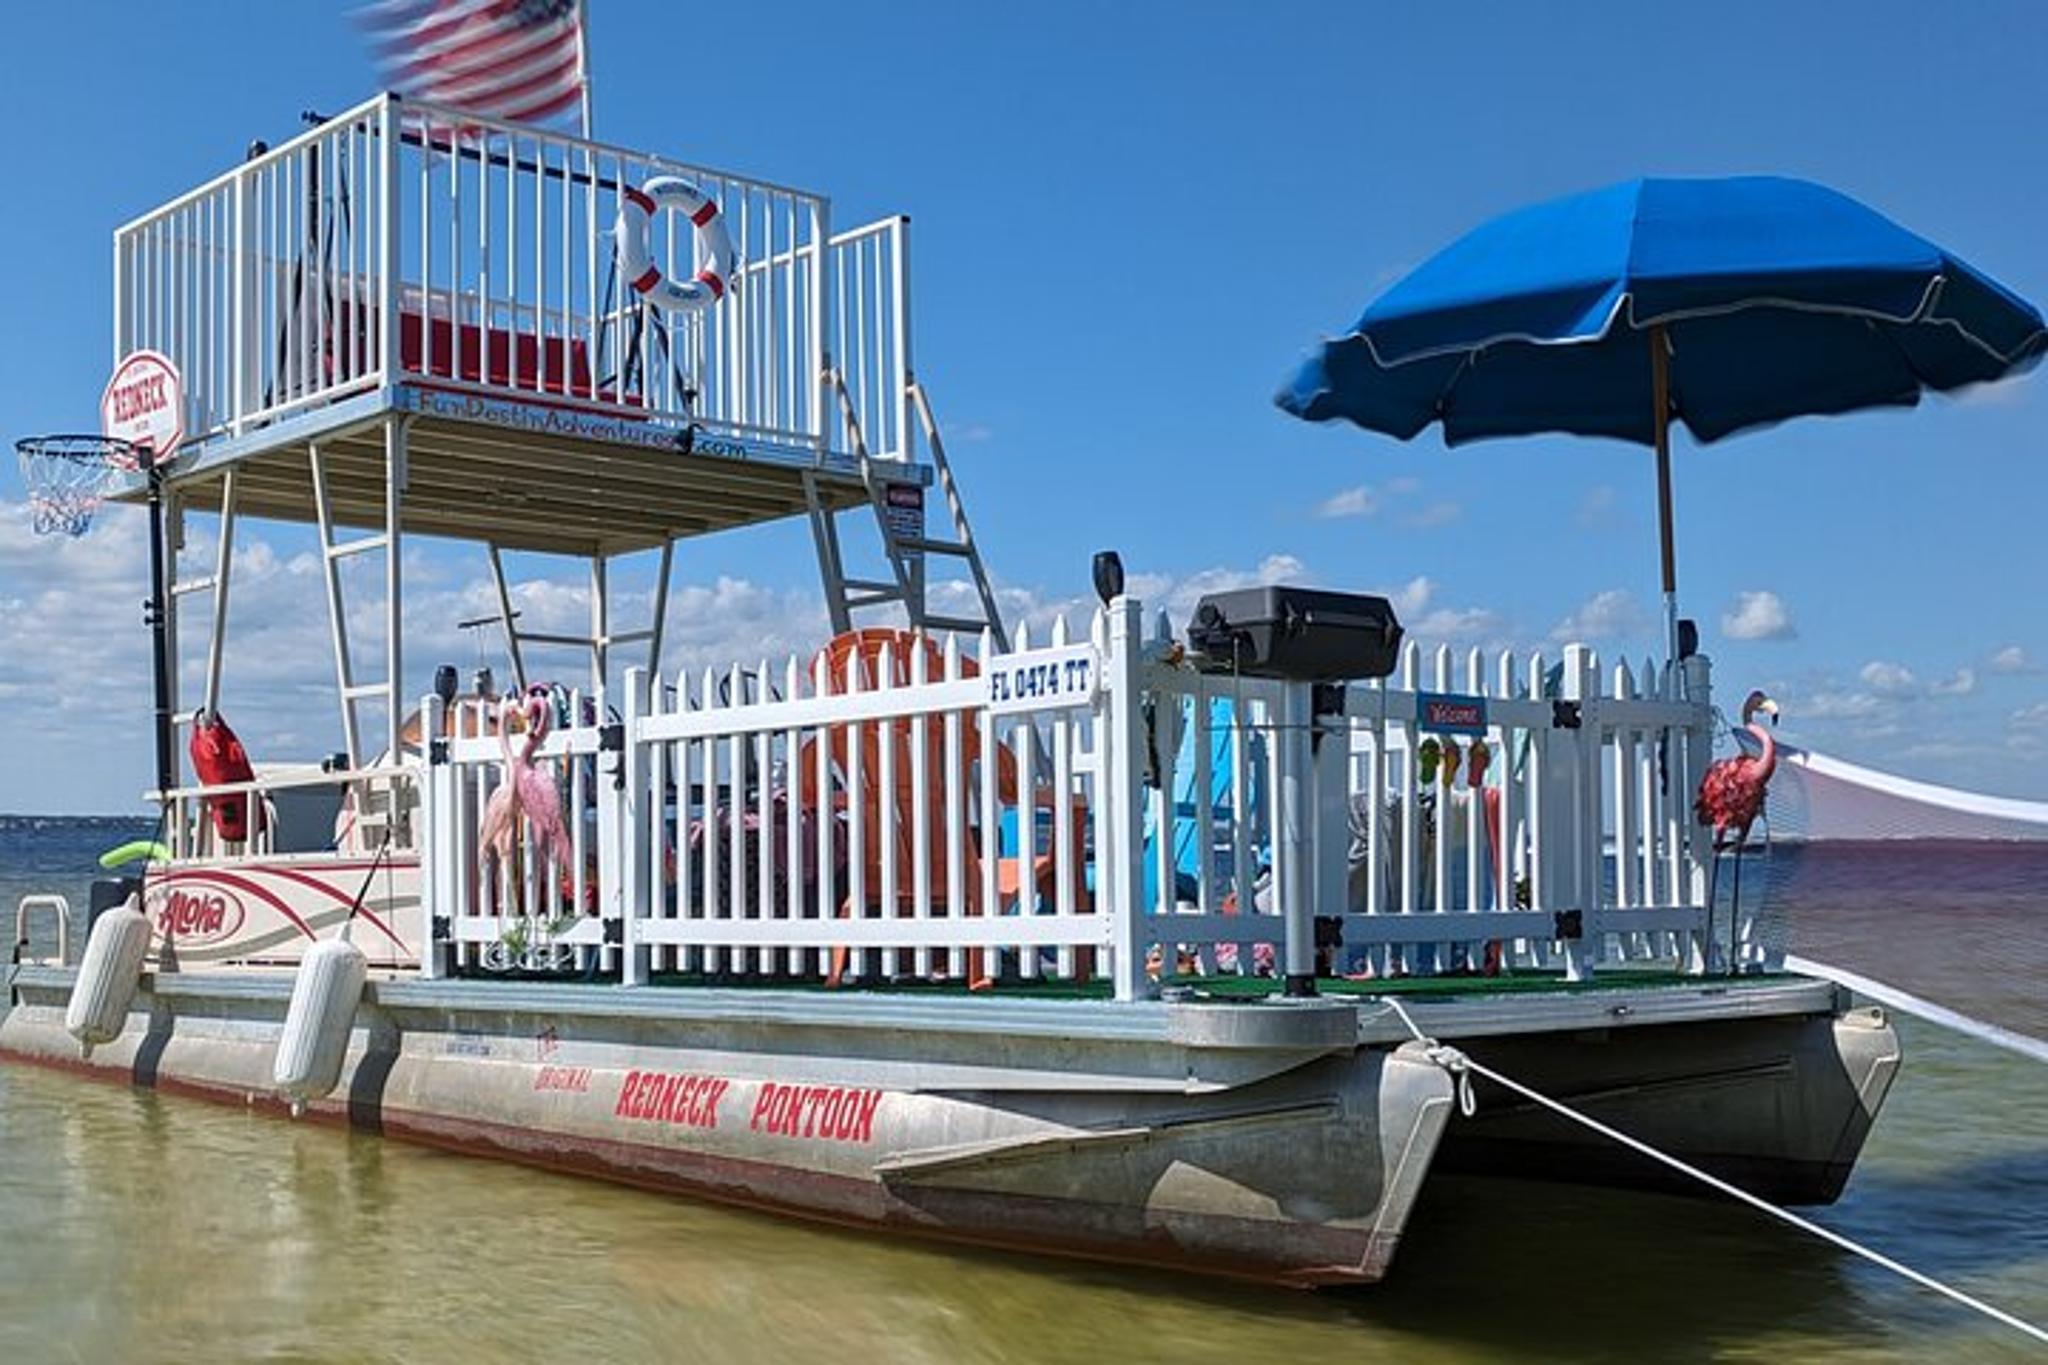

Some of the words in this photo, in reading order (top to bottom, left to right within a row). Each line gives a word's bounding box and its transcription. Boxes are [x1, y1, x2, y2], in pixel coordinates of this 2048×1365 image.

[991, 671, 1010, 701] FL
[1016, 663, 1059, 699] 0474
[1065, 659, 1089, 692] TT
[615, 1070, 729, 1128] REDNECK
[750, 1082, 883, 1142] PONTOON
